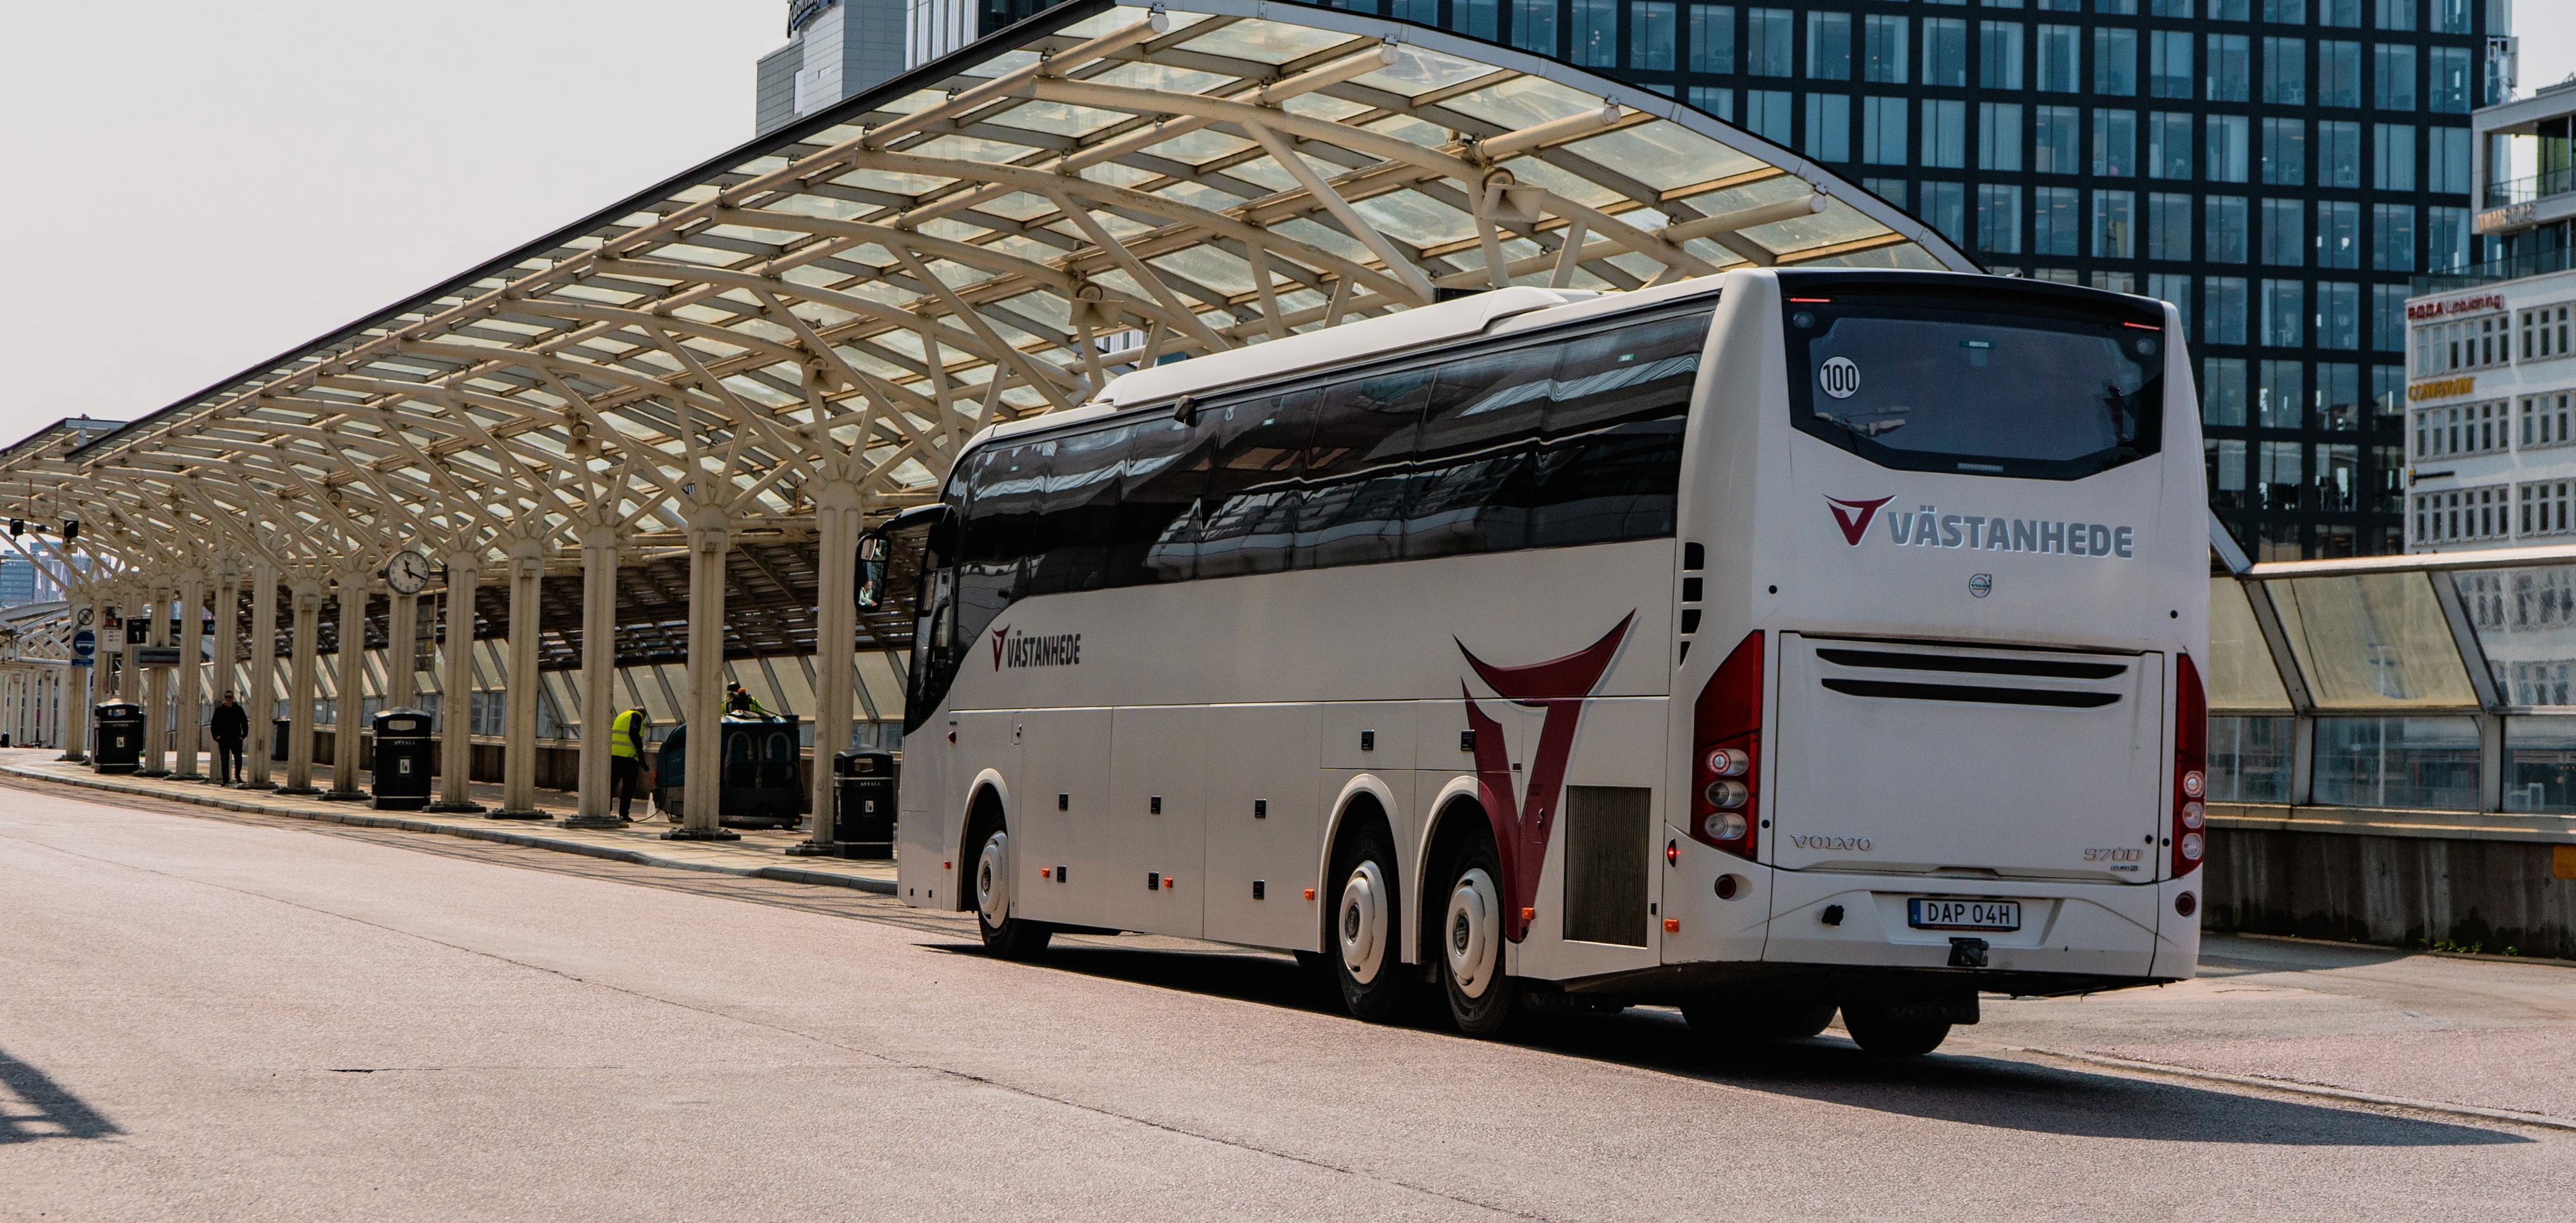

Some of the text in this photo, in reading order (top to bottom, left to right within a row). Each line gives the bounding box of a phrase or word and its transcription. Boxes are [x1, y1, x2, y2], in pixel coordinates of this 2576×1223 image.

[1823, 364, 1857, 392] 100
[1887, 505, 2134, 560] VÄSTANHEDE
[135, 631, 140, 641] 1
[1007, 630, 1081, 668] VÄSTANHEDE
[1790, 834, 1874, 851] VOLVO
[2084, 848, 2143, 862] 9700
[1928, 903, 2010, 925] DAP 04H
